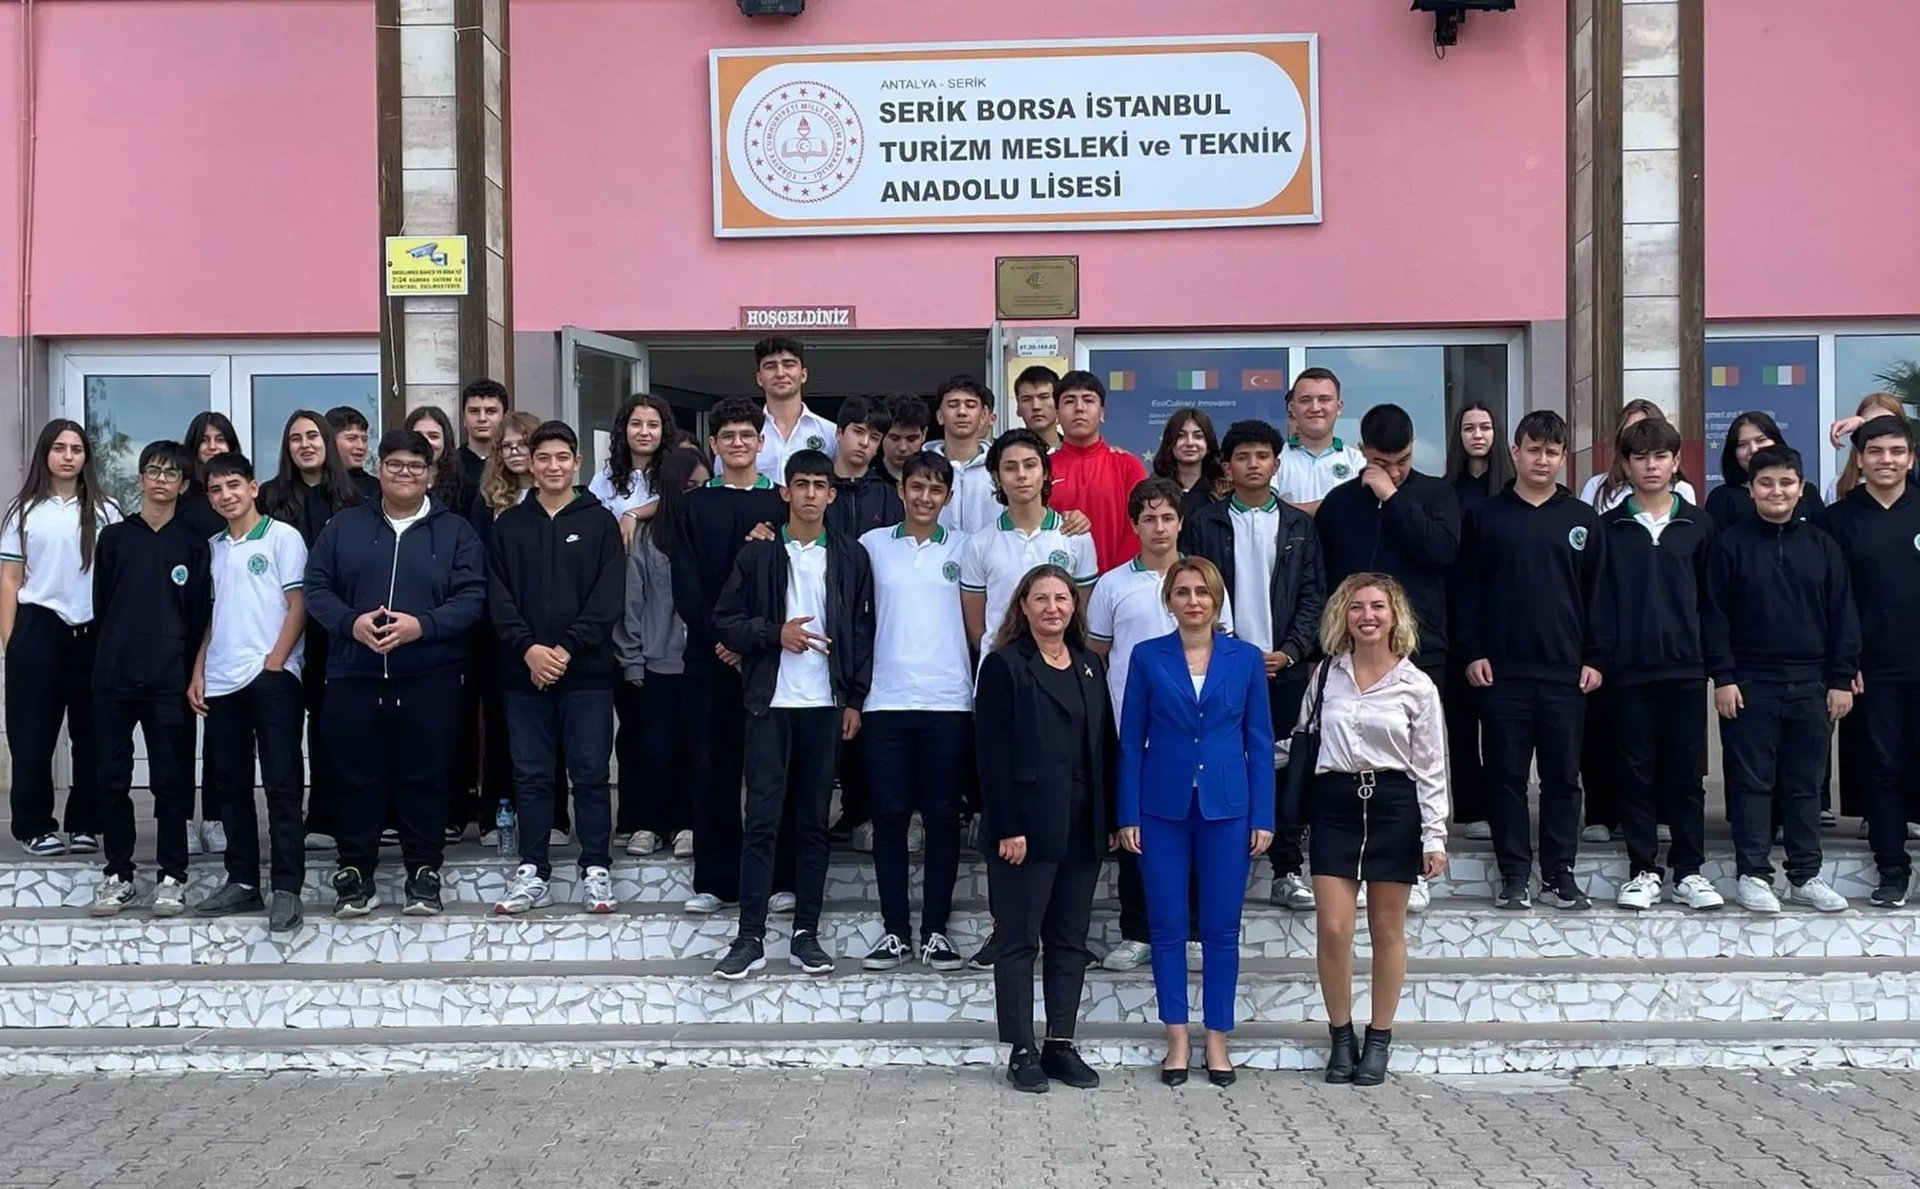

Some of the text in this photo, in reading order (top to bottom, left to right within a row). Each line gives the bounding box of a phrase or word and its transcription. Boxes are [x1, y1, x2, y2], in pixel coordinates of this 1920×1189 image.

[880, 79, 938, 90] ANTALYA
[947, 77, 987, 89] SERİK
[878, 91, 1232, 124] SERİK BORSA İSTANBUL
[878, 126, 1293, 163] TURİZM MESLEKİ ve TEKNİK
[880, 170, 1121, 203] ANADOLU LİSESİ
[747, 307, 850, 328] HOŞGELDİNİZ
[1151, 399, 1237, 408] EcoCulinary Innovators
